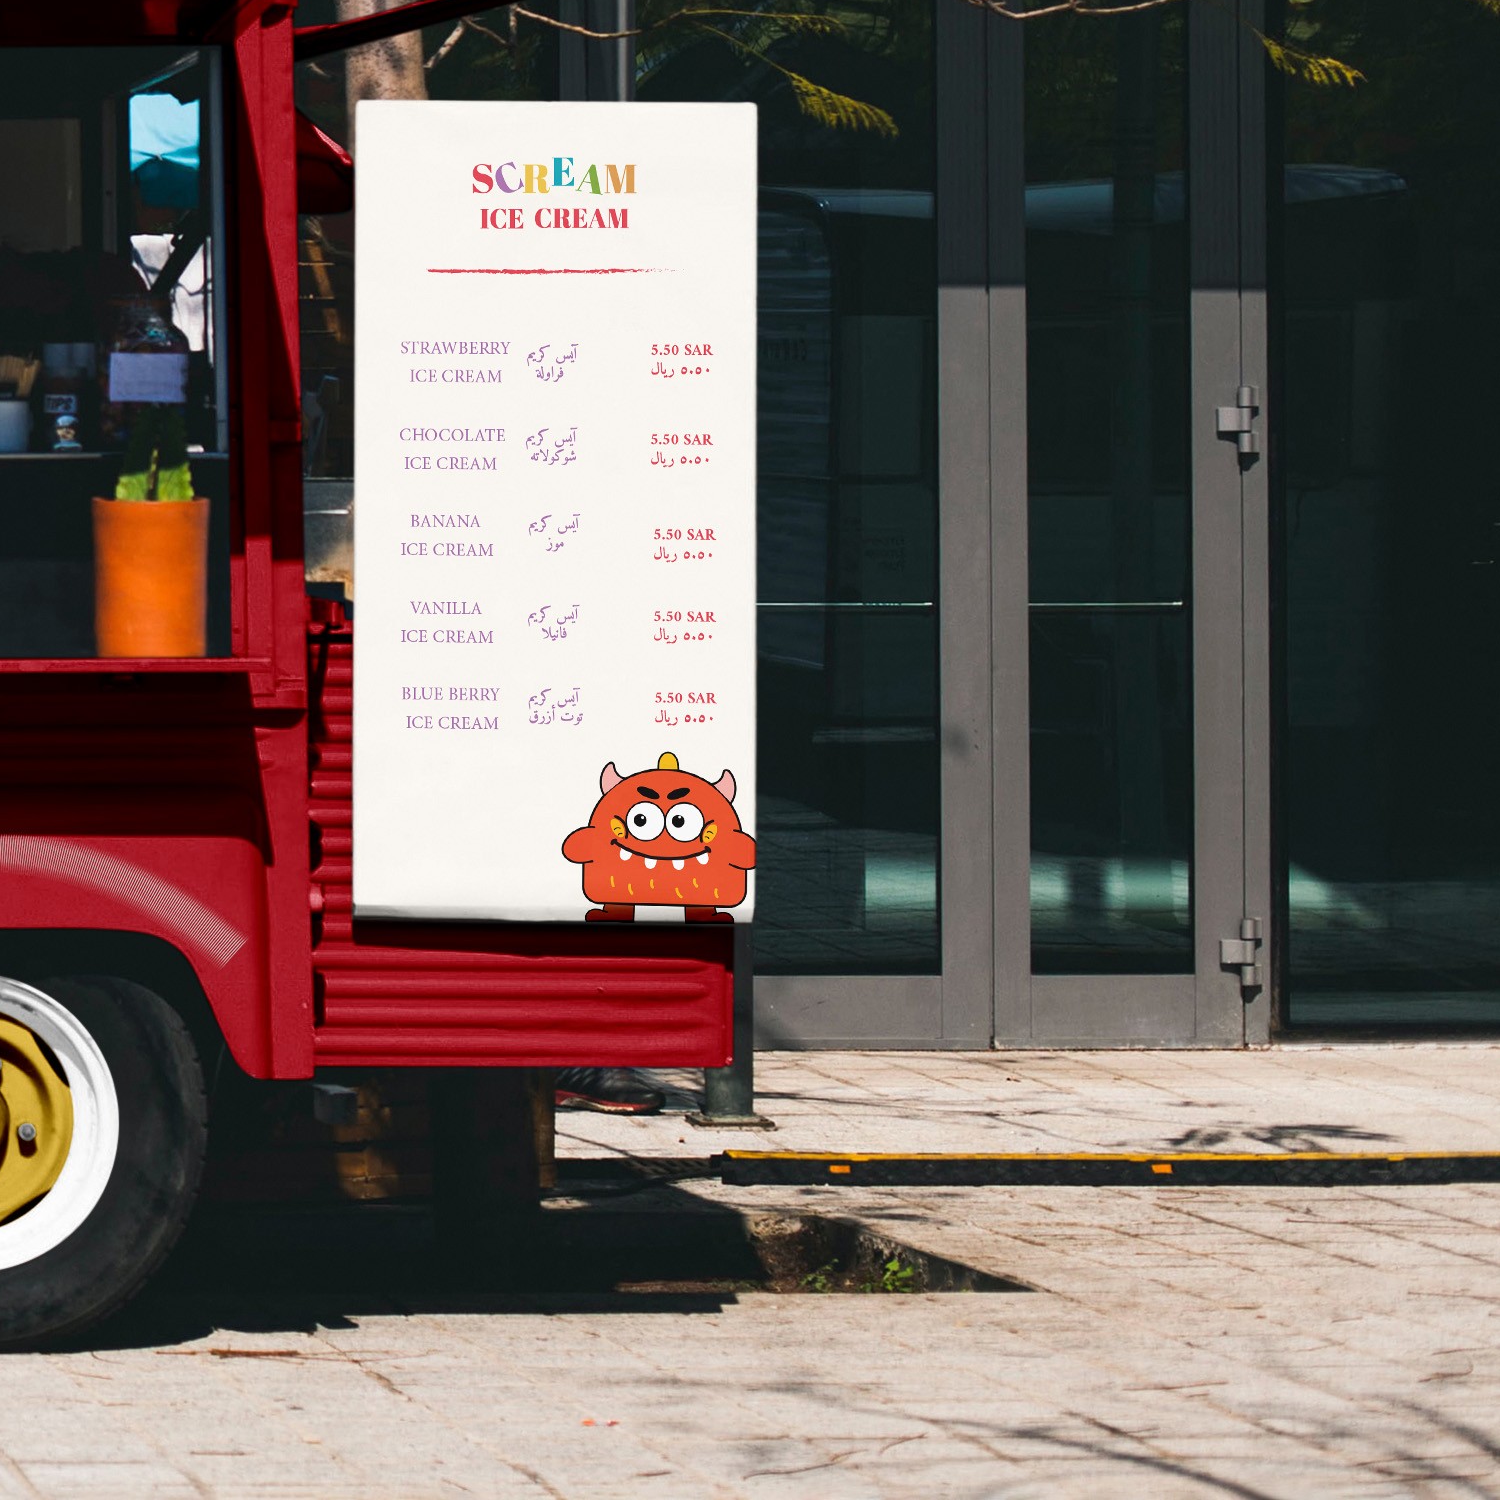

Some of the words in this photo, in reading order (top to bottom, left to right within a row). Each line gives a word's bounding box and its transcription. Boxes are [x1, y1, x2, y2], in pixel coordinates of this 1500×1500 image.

[472, 156, 637, 195] SCREAM
[480, 208, 524, 229] ICE
[534, 208, 629, 229] CREAM
[400, 341, 511, 355] STRAWBERRY
[526, 344, 551, 366] كريم
[555, 343, 579, 364] آيس
[650, 344, 680, 356] 5.50
[684, 343, 714, 356] SAR
[410, 369, 438, 383] ICE
[441, 369, 502, 383] CREAM
[650, 362, 675, 378] ريال
[399, 428, 506, 442] CHOCOLATE
[525, 428, 550, 449] كريم
[554, 427, 578, 448] آيس
[650, 433, 679, 446] 5.50
[683, 433, 714, 446] SAR
[404, 456, 432, 470] ICE
[436, 456, 497, 470] CREAM
[650, 451, 675, 468] ريال
[410, 514, 481, 528] BANANA
[528, 514, 552, 536] كريم
[557, 513, 581, 534] آيس
[653, 528, 682, 541] 5.50
[687, 528, 717, 541] SAR
[401, 542, 428, 556] ICE
[432, 542, 494, 556] CREAM
[545, 537, 565, 552] موز
[653, 546, 678, 563] ريال
[410, 600, 482, 615] VANILLA
[556, 604, 580, 625] آيس
[527, 605, 552, 627] كريم
[653, 610, 682, 623] 5.50
[686, 610, 717, 623] SAR
[400, 629, 428, 643] ICE
[432, 629, 494, 644] CREAM
[653, 627, 678, 645] ريال
[402, 686, 444, 701] BLUE
[448, 687, 500, 701] BERRY
[528, 688, 552, 710] كريم
[557, 687, 581, 708] آيس
[654, 692, 683, 704] 5.50
[687, 692, 718, 705] SAR
[406, 715, 433, 729] ICE
[438, 716, 499, 730] CREAM
[560, 711, 584, 726] توت
[654, 709, 679, 727] ريال
